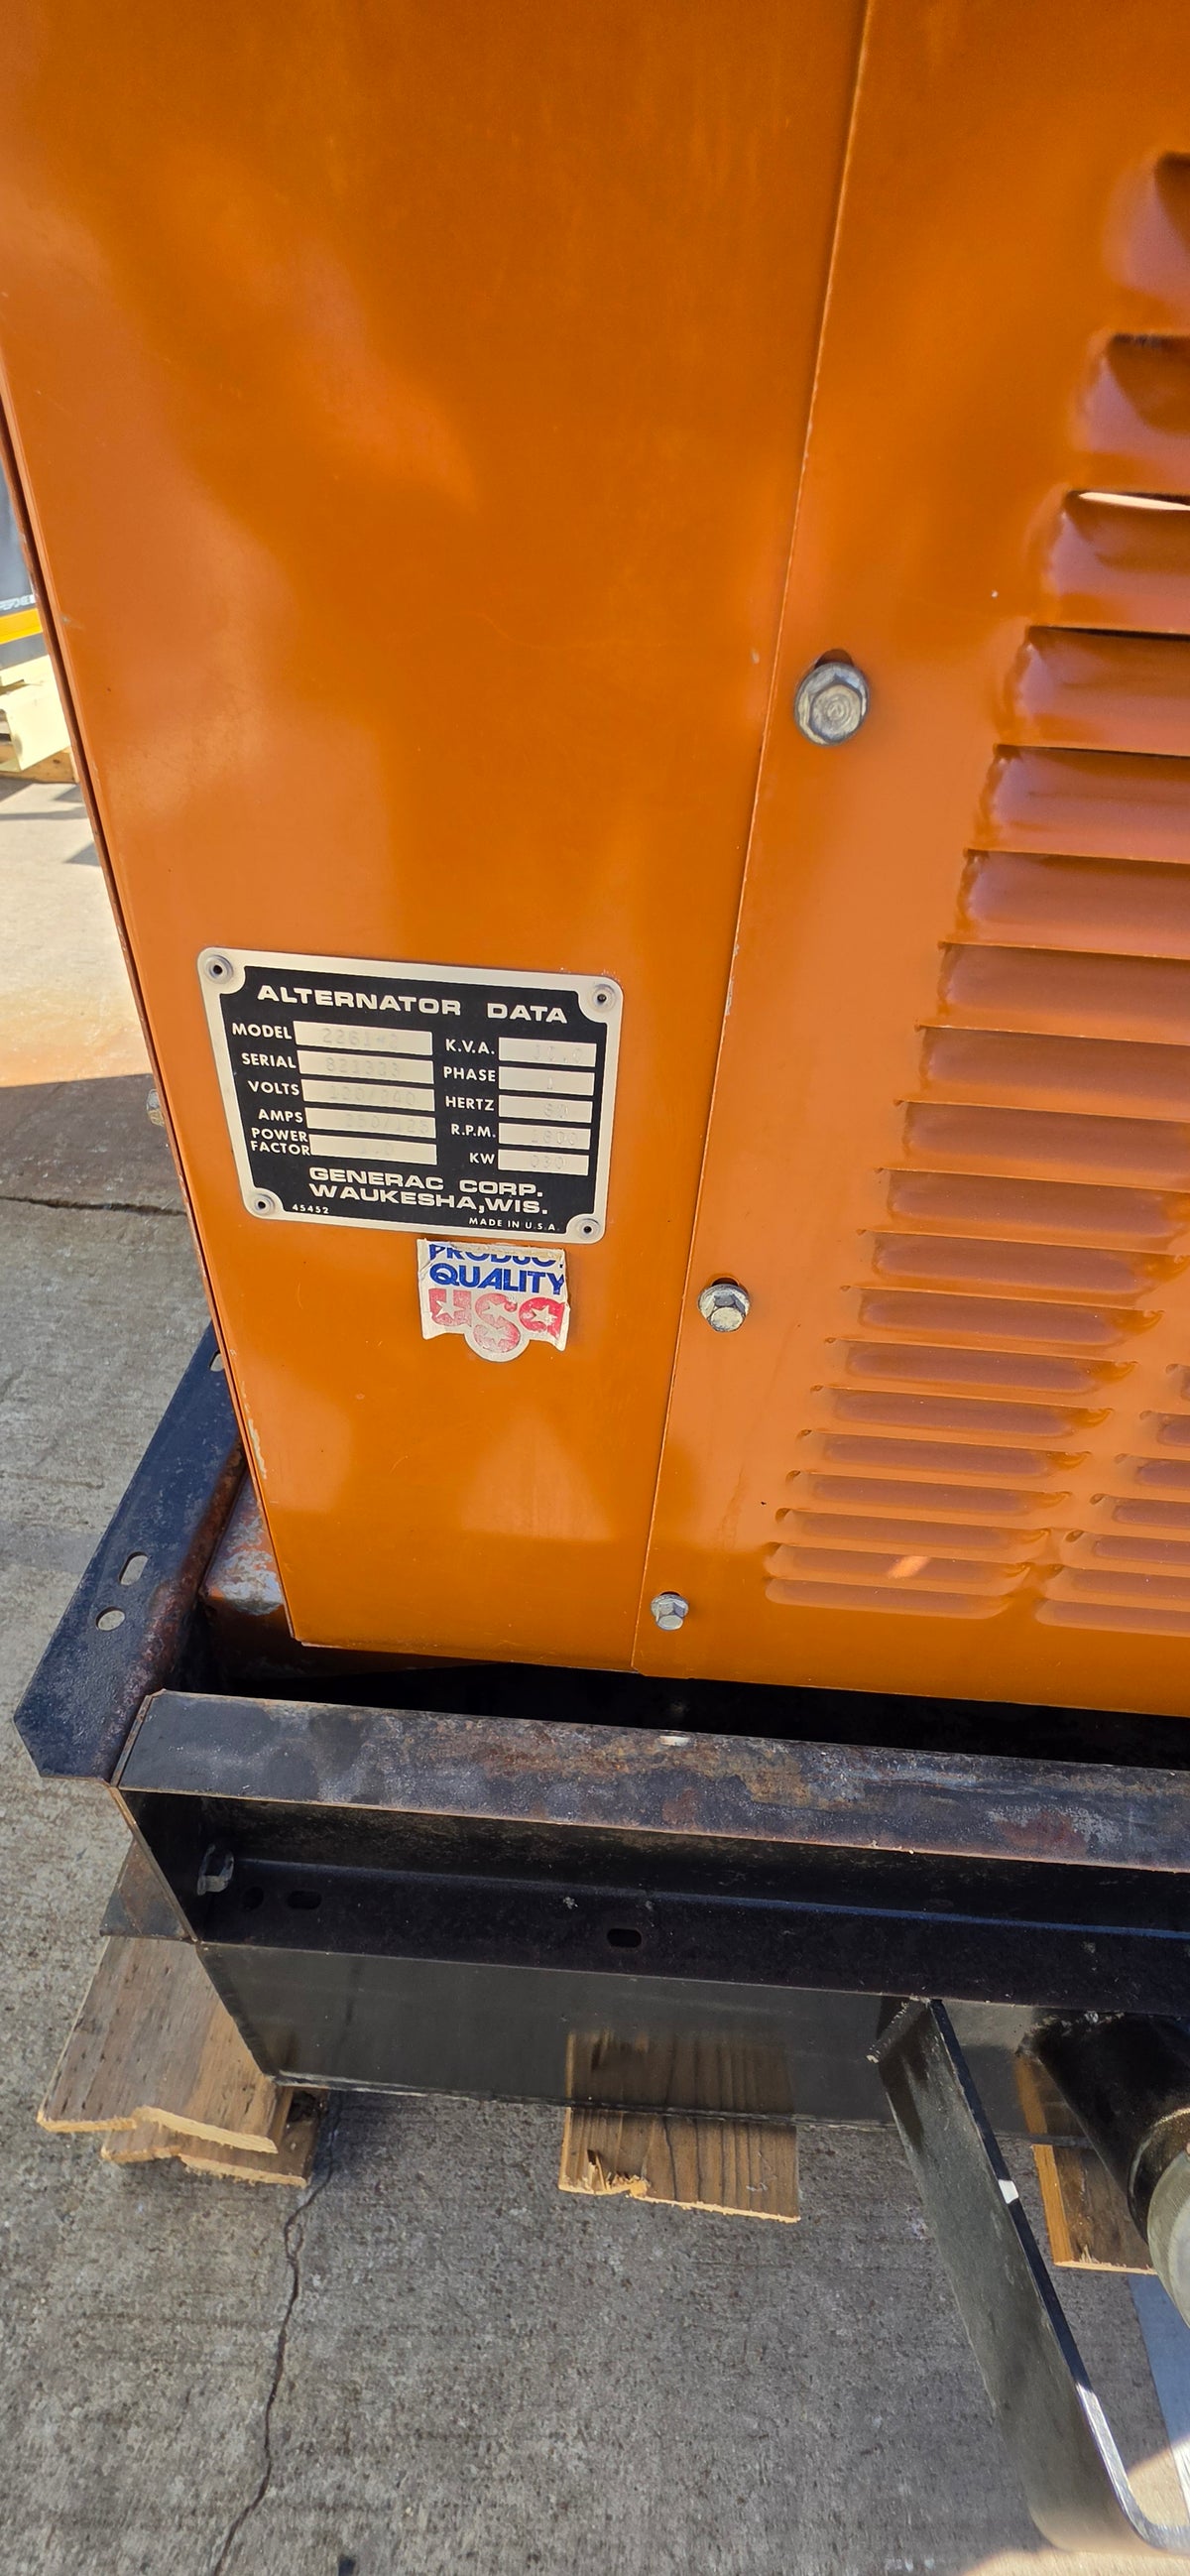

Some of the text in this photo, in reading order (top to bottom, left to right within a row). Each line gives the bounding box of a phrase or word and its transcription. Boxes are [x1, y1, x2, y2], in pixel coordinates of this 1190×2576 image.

[257, 984, 568, 1024] ALTERNATOR DATA
[231, 1022, 293, 1040] MODEL
[445, 1038, 496, 1054] K.V.A.
[241, 1051, 297, 1069] SERIAL
[442, 1065, 496, 1082] PHASE
[247, 1079, 299, 1096] VOLTS
[445, 1095, 495, 1111] HERTZ
[257, 1108, 303, 1124] AMPS
[250, 1127, 308, 1143] POWER
[450, 1123, 496, 1139] R.P.M.
[250, 1140, 311, 1157] FACTOR
[469, 1152, 496, 1165] KW
[308, 1166, 544, 1197] GENERAC CORP.
[292, 1203, 330, 1214] 45452
[468, 1217, 503, 1228] MADE
[507, 1219, 521, 1229] IN
[428, 1262, 565, 1295] QUALITY
